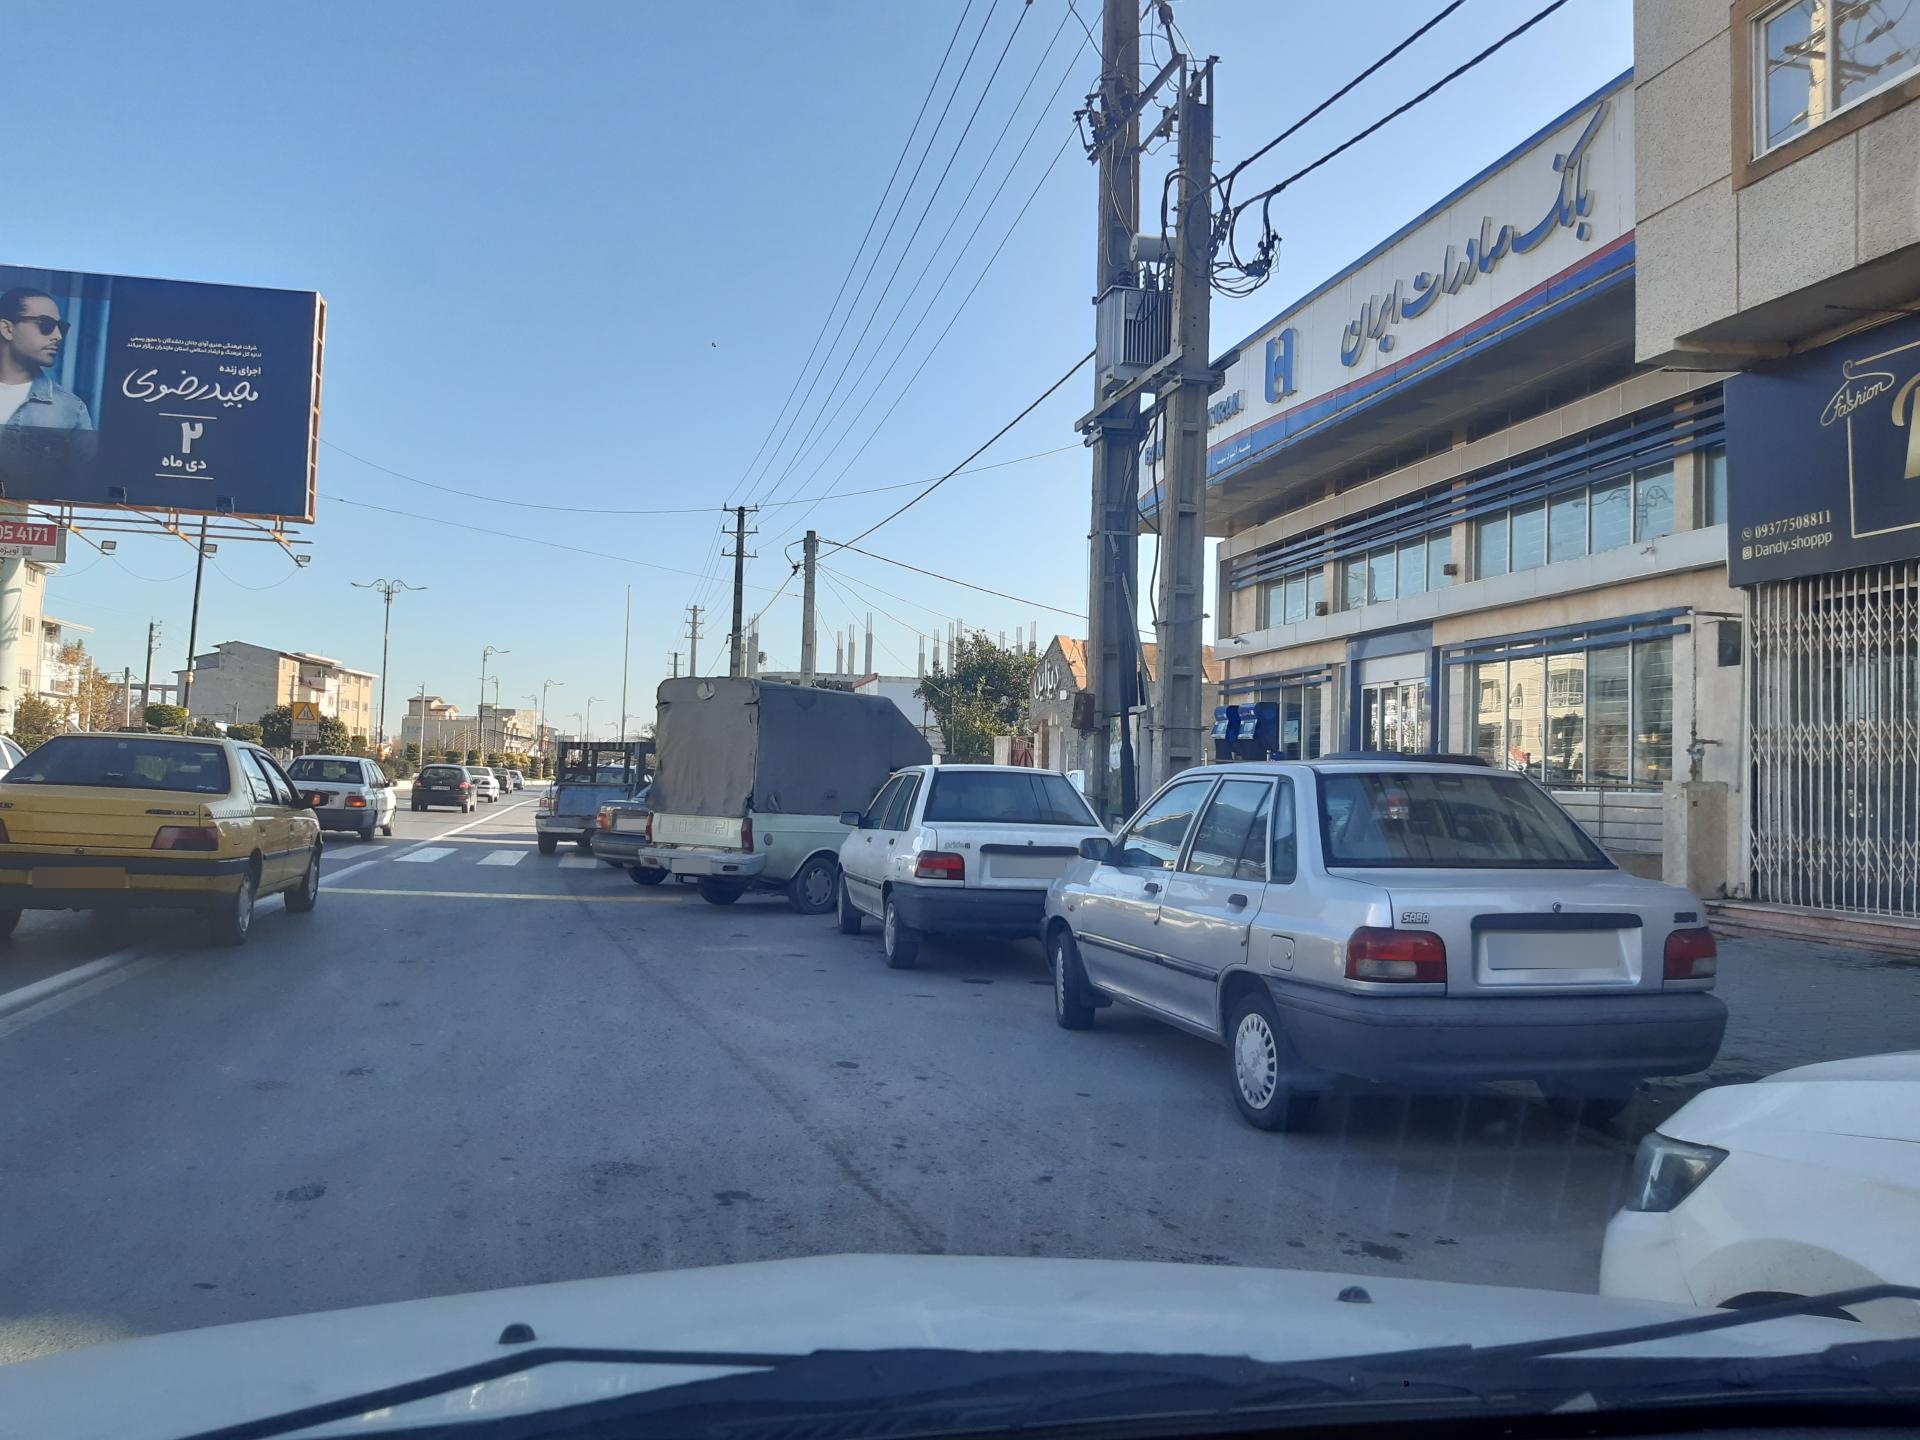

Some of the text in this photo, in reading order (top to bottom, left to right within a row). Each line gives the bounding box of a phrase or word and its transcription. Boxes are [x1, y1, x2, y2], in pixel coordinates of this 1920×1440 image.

[1341, 100, 1611, 367] بانک صادرات ایران
[219, 364, 262, 377] اجرای زنده
[122, 367, 259, 408] مجید رضوی
[181, 421, 203, 454] ۲
[161, 454, 207, 472] دی ماه
[16, 526, 48, 542] 4171
[1754, 509, 1831, 539] 09377508811
[1754, 531, 1833, 558] Dandy.shoppp
[1401, 911, 1430, 925] SABA
